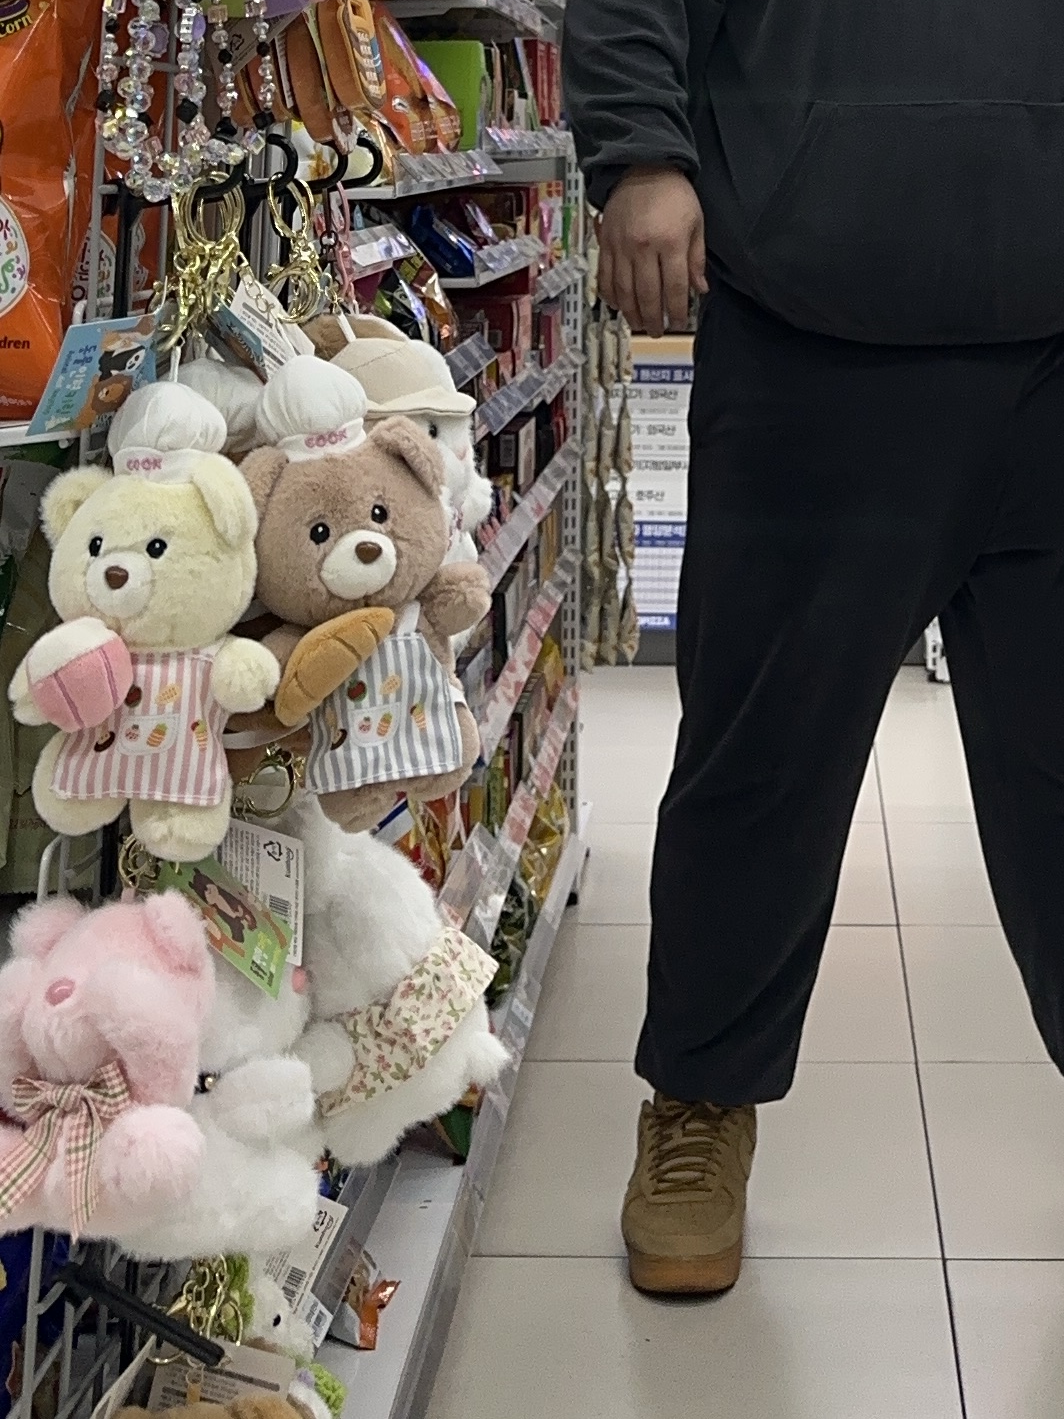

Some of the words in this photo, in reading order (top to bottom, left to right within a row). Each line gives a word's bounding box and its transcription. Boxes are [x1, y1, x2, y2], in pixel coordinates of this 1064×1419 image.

[0, 334, 31, 350] dren
[304, 429, 349, 449] COOK
[126, 456, 163, 472] COOK
